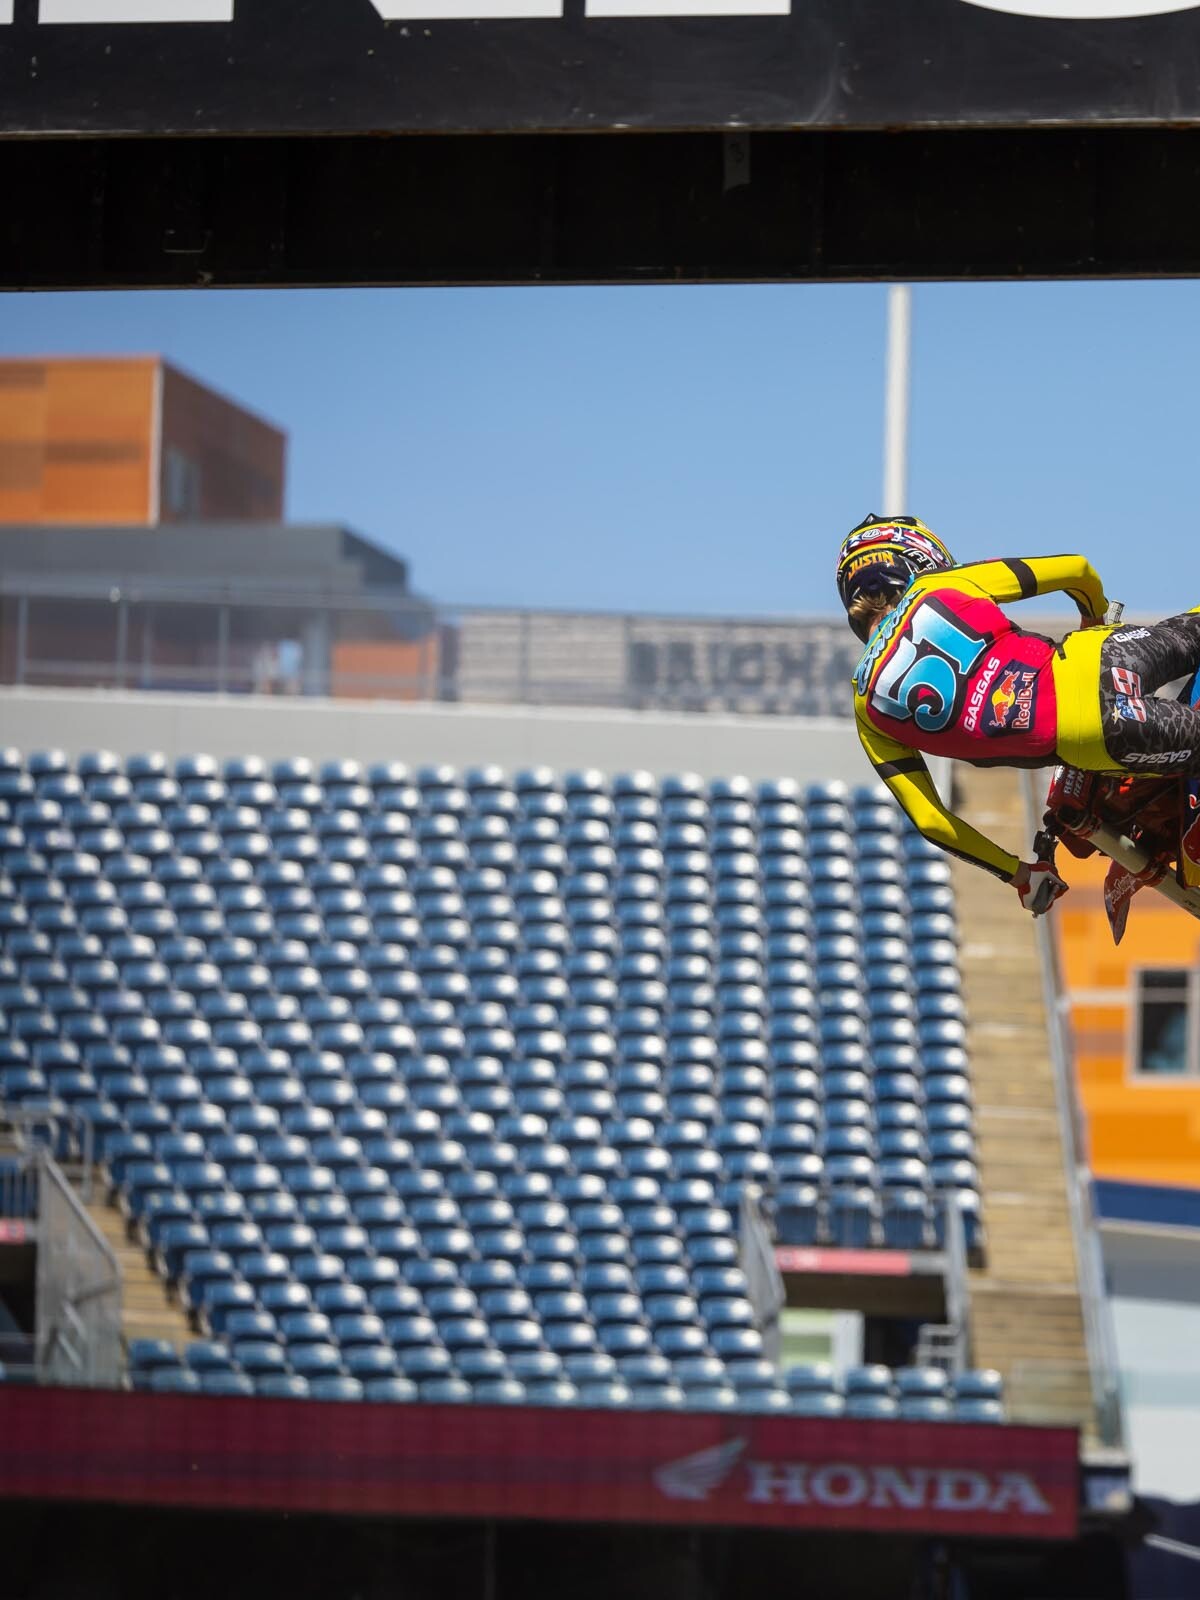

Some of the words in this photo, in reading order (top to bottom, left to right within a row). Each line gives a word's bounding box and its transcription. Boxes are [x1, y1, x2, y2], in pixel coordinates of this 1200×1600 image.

[847, 551, 895, 580] JUSTIN
[1112, 628, 1151, 643] GASGAS
[870, 602, 988, 731] 51
[963, 657, 1000, 732] GASGAS
[1018, 671, 1037, 702] Bull
[1012, 698, 1029, 730] Red
[1120, 749, 1192, 765] GASGAS
[747, 1461, 1052, 1514] HONDA
